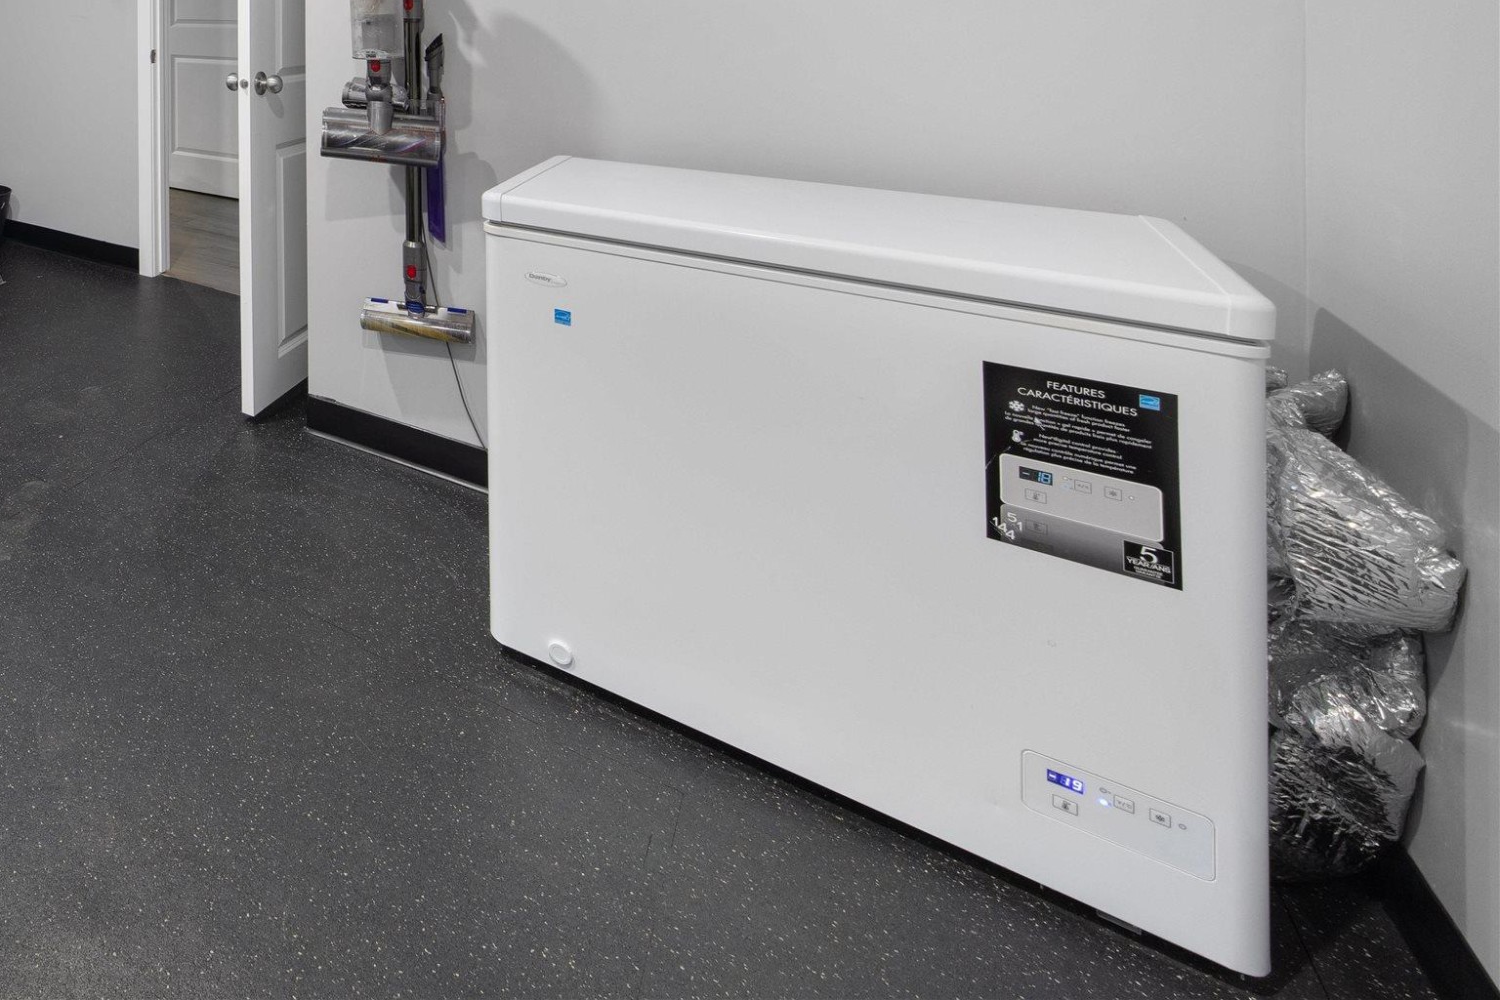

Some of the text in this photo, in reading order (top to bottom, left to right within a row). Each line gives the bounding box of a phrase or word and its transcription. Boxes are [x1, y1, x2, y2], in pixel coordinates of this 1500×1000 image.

[1046, 380, 1106, 399] FEATURES
[1017, 387, 1138, 417] CARACTÉRISTIQUES
[1140, 545, 1158, 564] 5
[1126, 555, 1171, 574] YEAR/ANS
